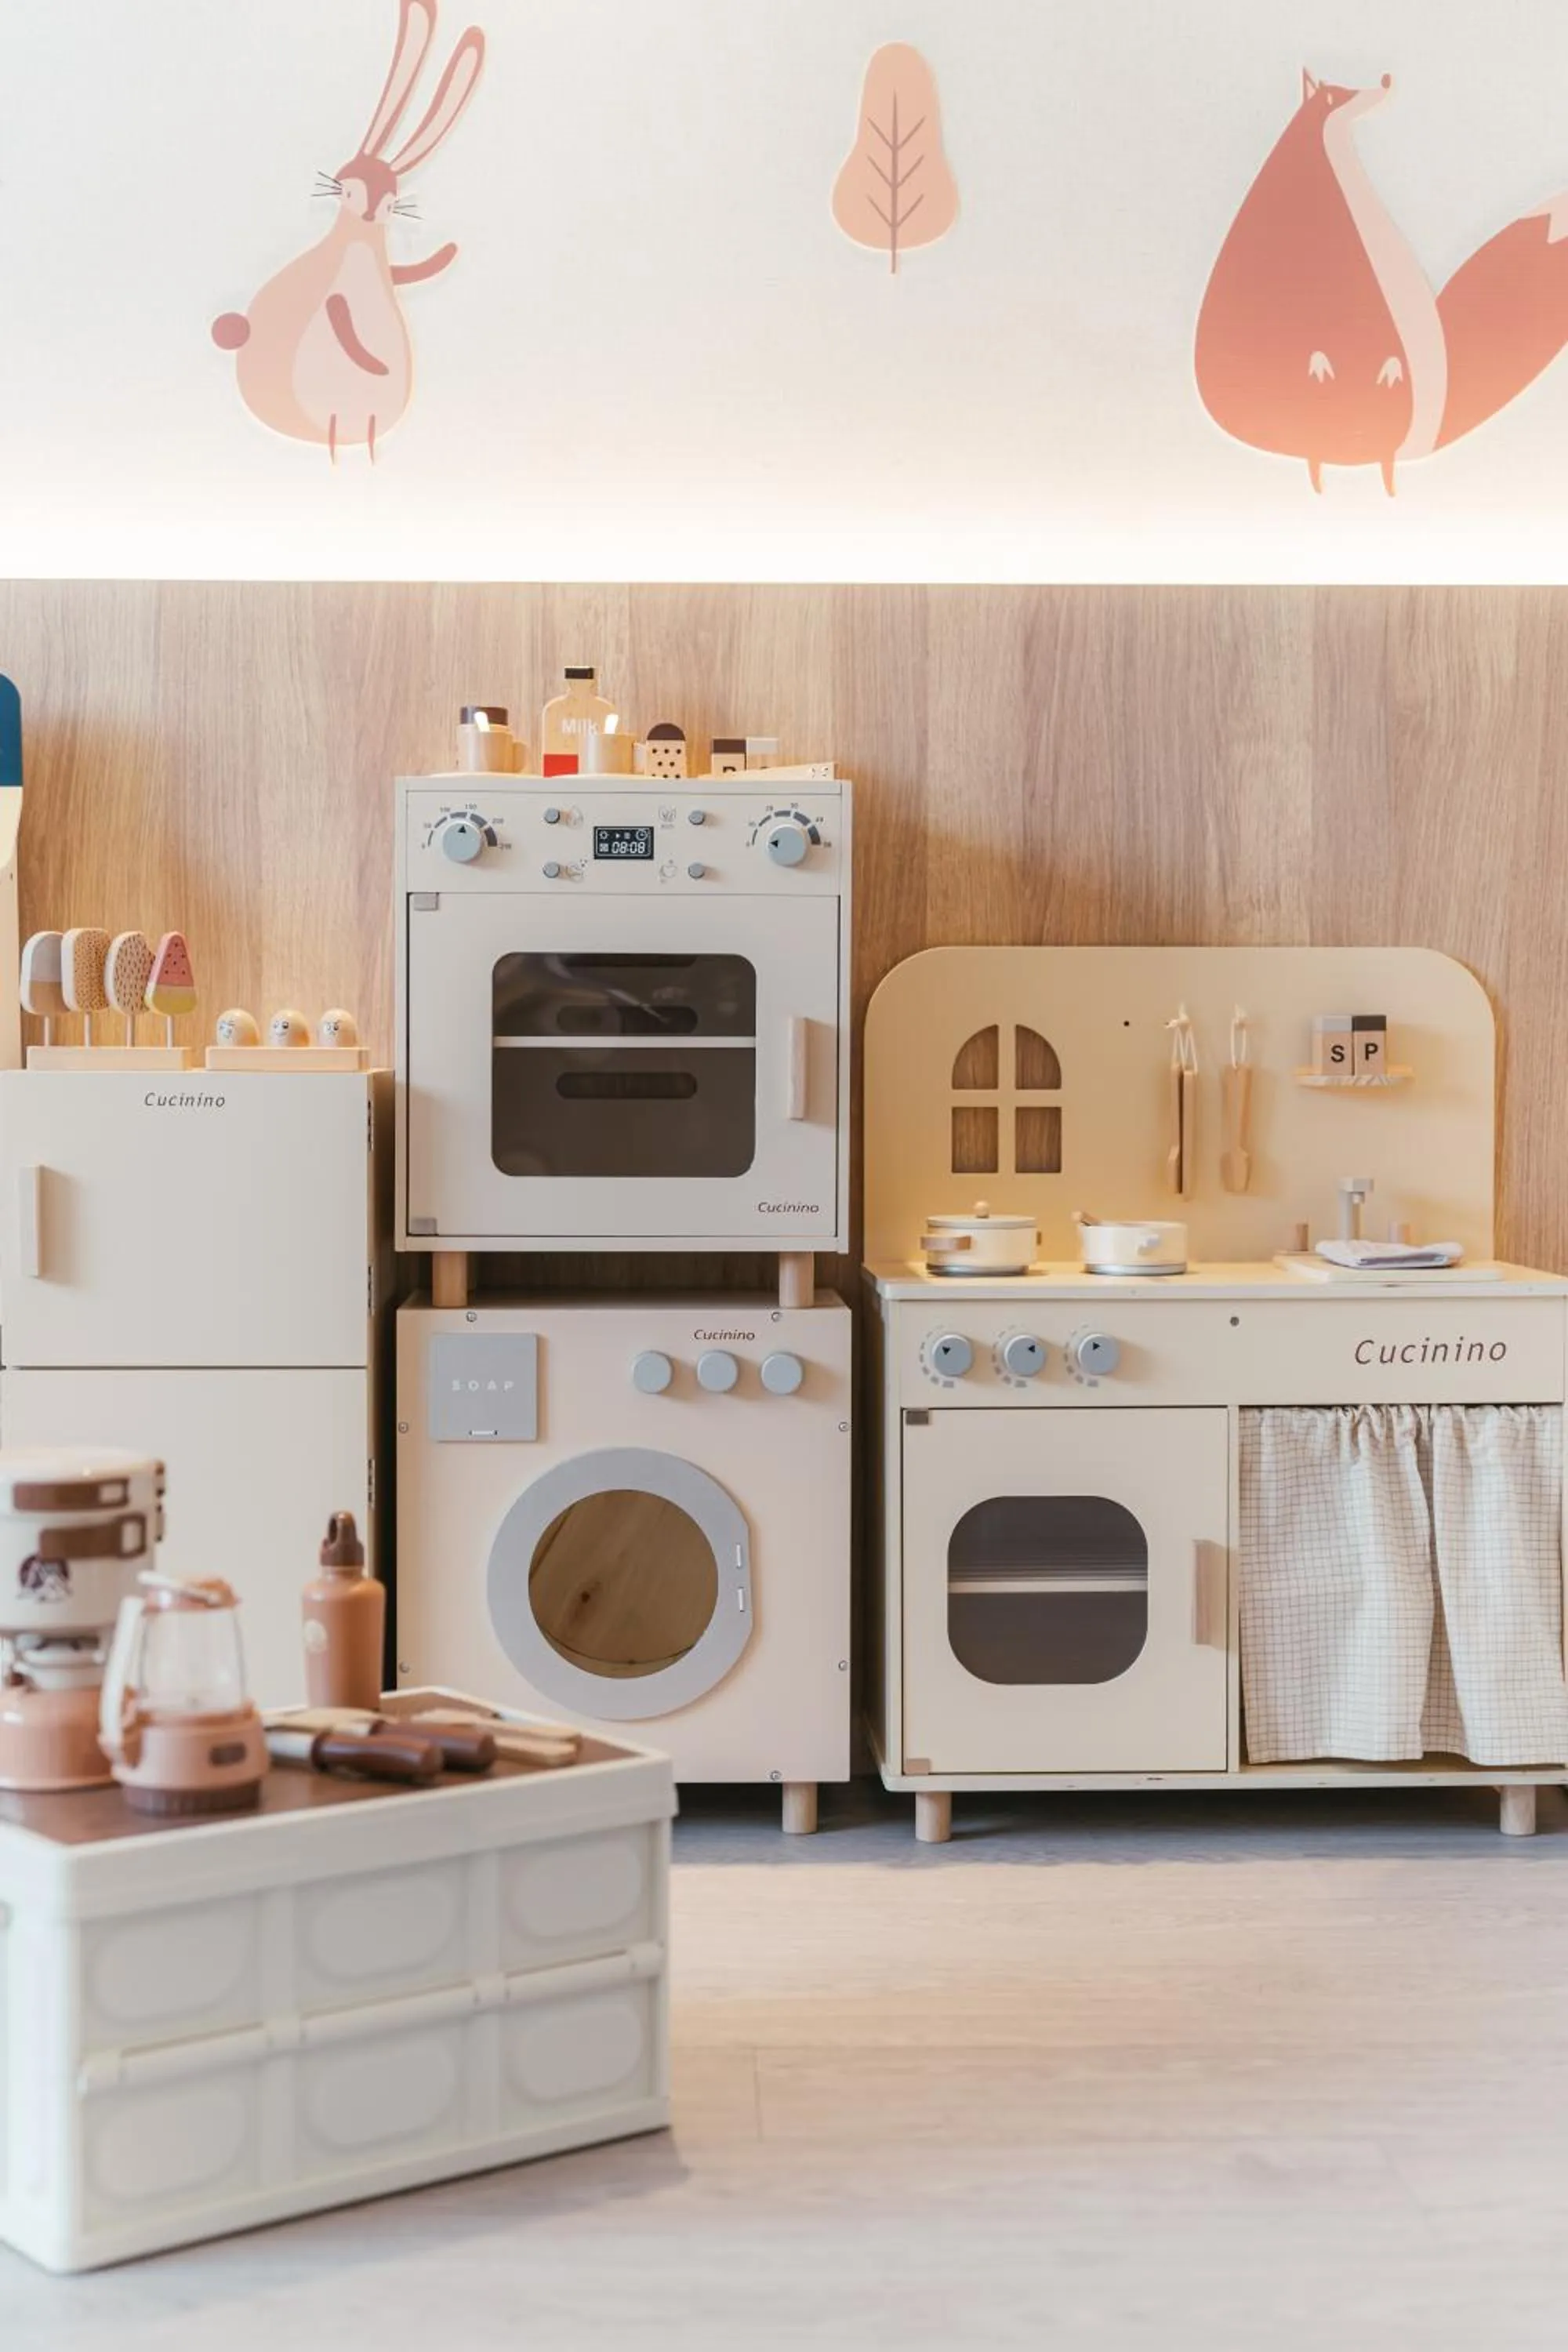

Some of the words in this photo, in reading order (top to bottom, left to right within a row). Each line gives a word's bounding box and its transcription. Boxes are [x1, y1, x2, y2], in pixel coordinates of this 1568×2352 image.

[561, 717, 600, 735] Milk
[1330, 1044, 1345, 1062] S
[1364, 1043, 1379, 1061] P
[144, 1092, 226, 1107] Cucinino
[758, 1200, 819, 1213] Cucinino
[694, 1329, 755, 1341] Cucinino
[1355, 1336, 1506, 1365] Cucinino
[452, 1380, 514, 1392] SOAP
